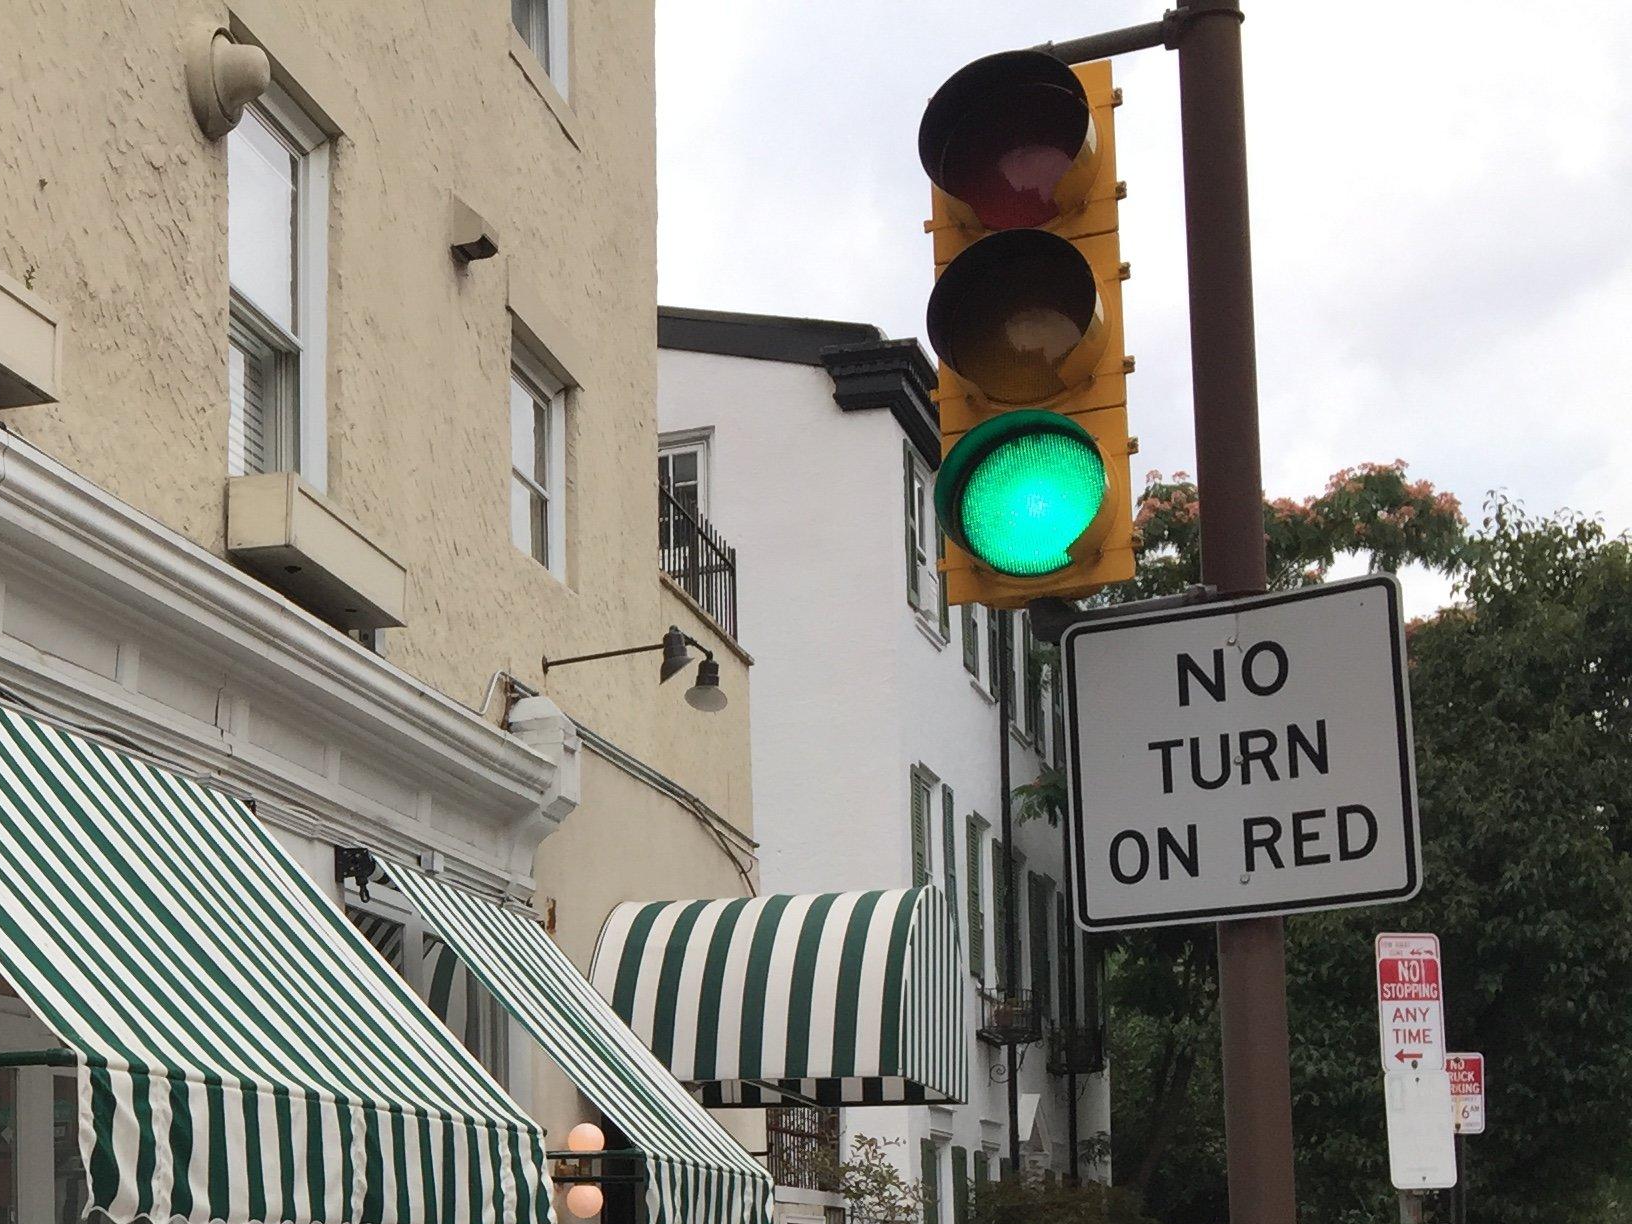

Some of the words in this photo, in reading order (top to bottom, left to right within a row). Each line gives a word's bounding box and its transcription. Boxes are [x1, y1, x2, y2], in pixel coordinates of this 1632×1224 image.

[1176, 640, 1289, 707] NO
[1148, 719, 1329, 794] TURN
[1109, 824, 1200, 885] ON
[1243, 803, 1378, 872] RED
[1397, 960, 1420, 982] NO
[1382, 982, 1438, 999] STOPPING
[1392, 1007, 1430, 1023] ANY
[1392, 1028, 1433, 1045] TIME
[1450, 1059, 1465, 1070] NO
[1449, 1071, 1475, 1082] RUCK
[1450, 1083, 1480, 1094] RKING
